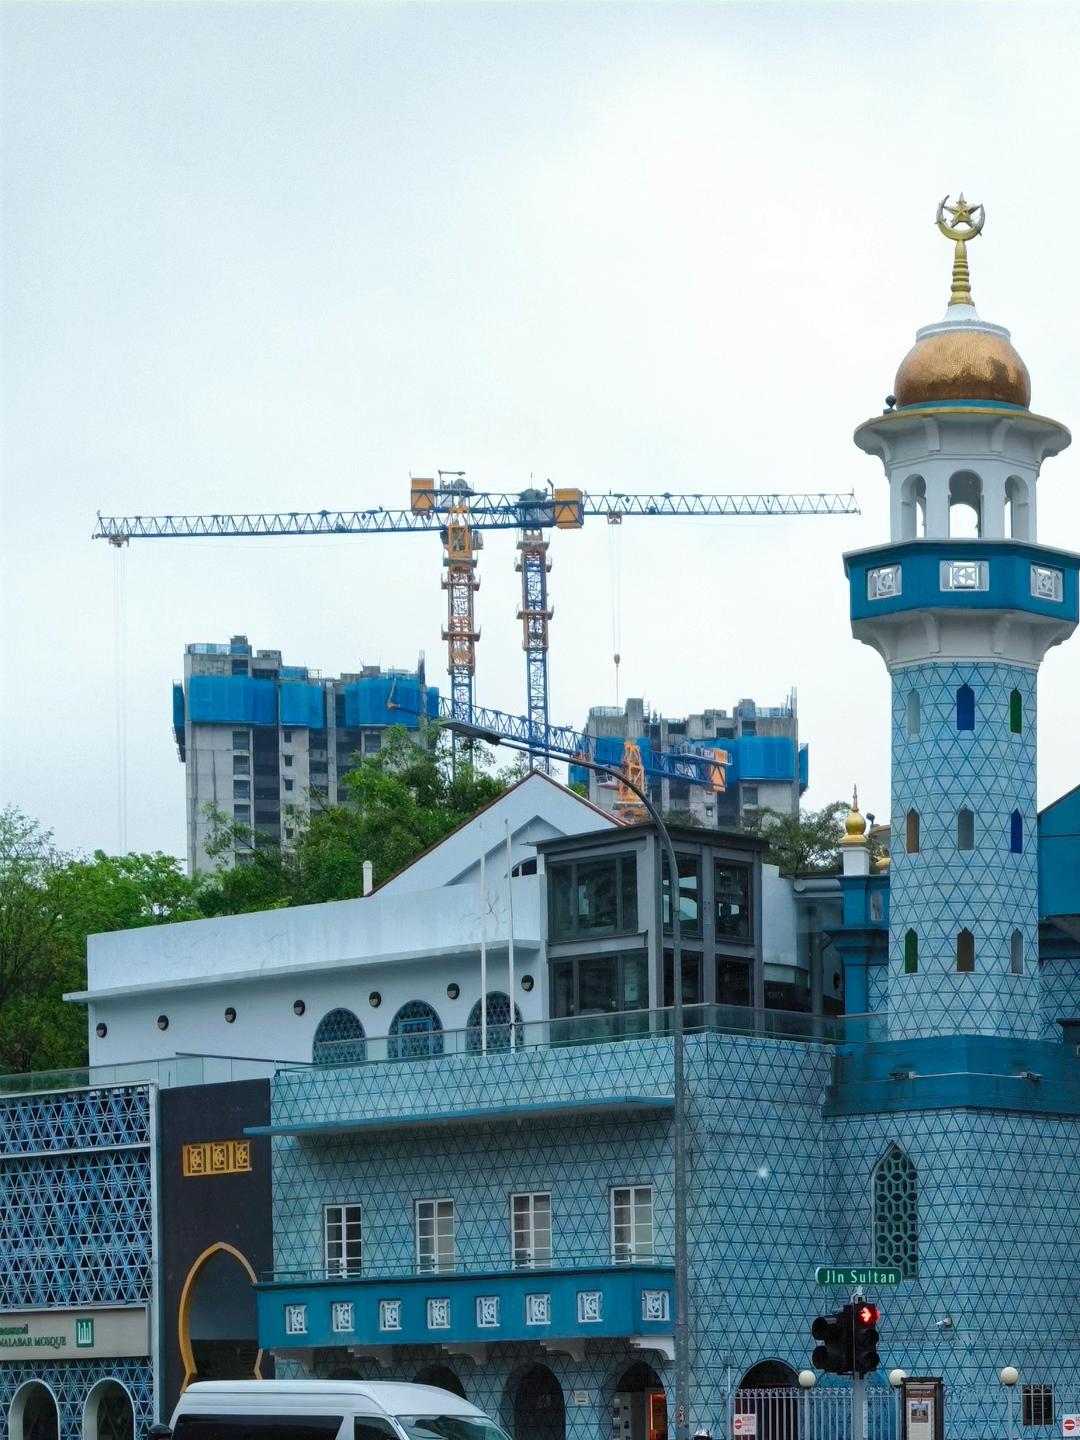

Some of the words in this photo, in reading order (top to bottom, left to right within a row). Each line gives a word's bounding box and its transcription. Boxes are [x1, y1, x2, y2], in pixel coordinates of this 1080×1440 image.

[824, 1270, 845, 1283] Jln
[850, 1270, 895, 1284] Sultan
[34, 1336, 67, 1350] MOSQUE
